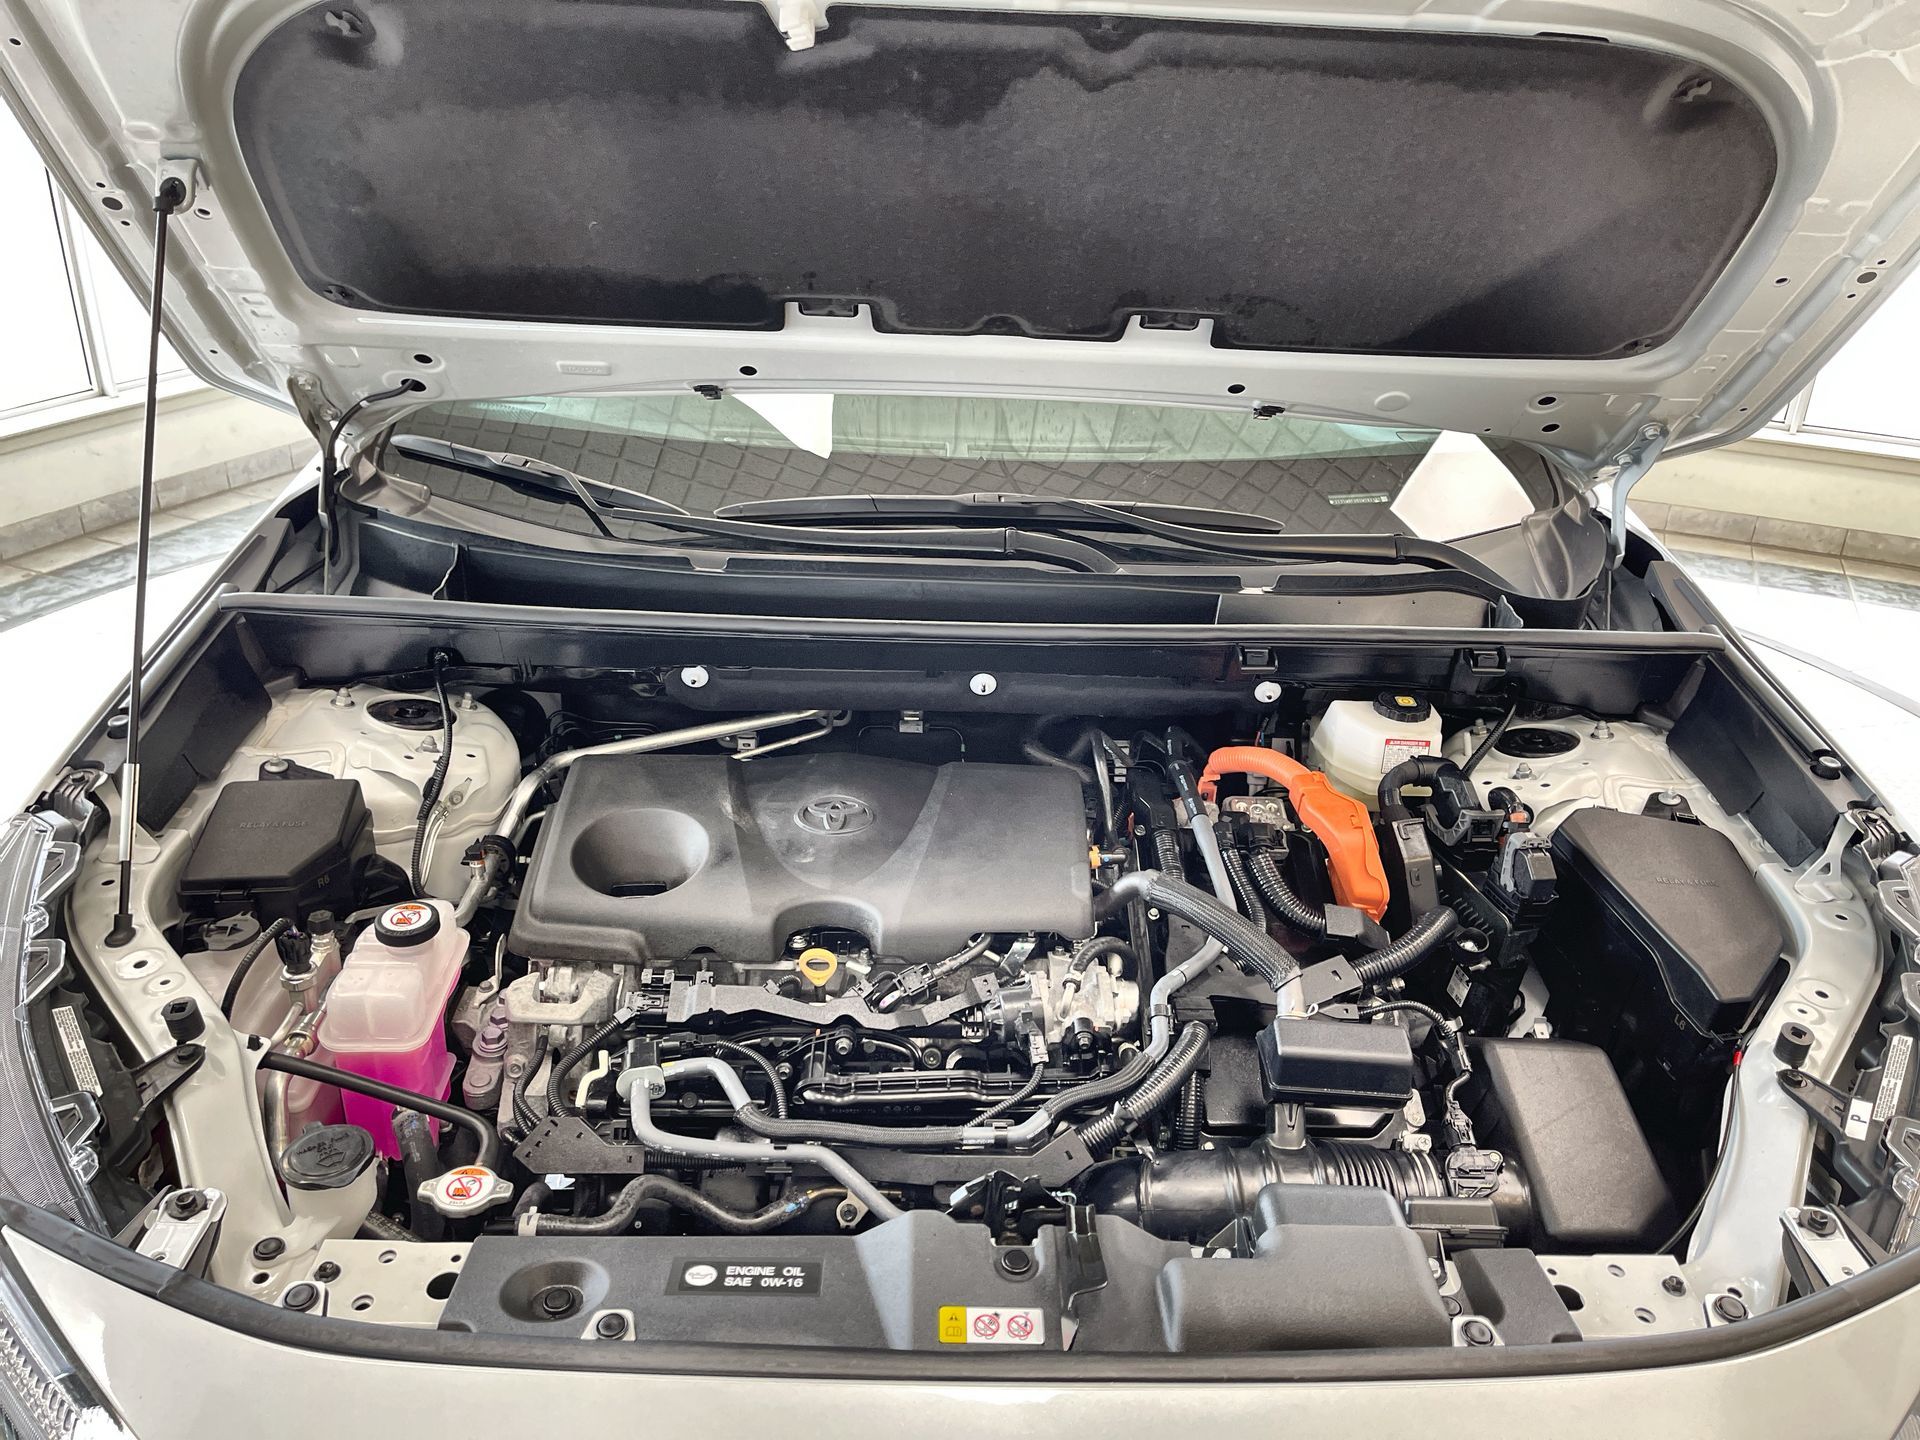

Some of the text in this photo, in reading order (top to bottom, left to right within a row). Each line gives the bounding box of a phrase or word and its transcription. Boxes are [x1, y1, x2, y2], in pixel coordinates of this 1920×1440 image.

[726, 1265, 805, 1277] ENGINE OIL
[723, 1276, 804, 1288] SAE 0W-16
